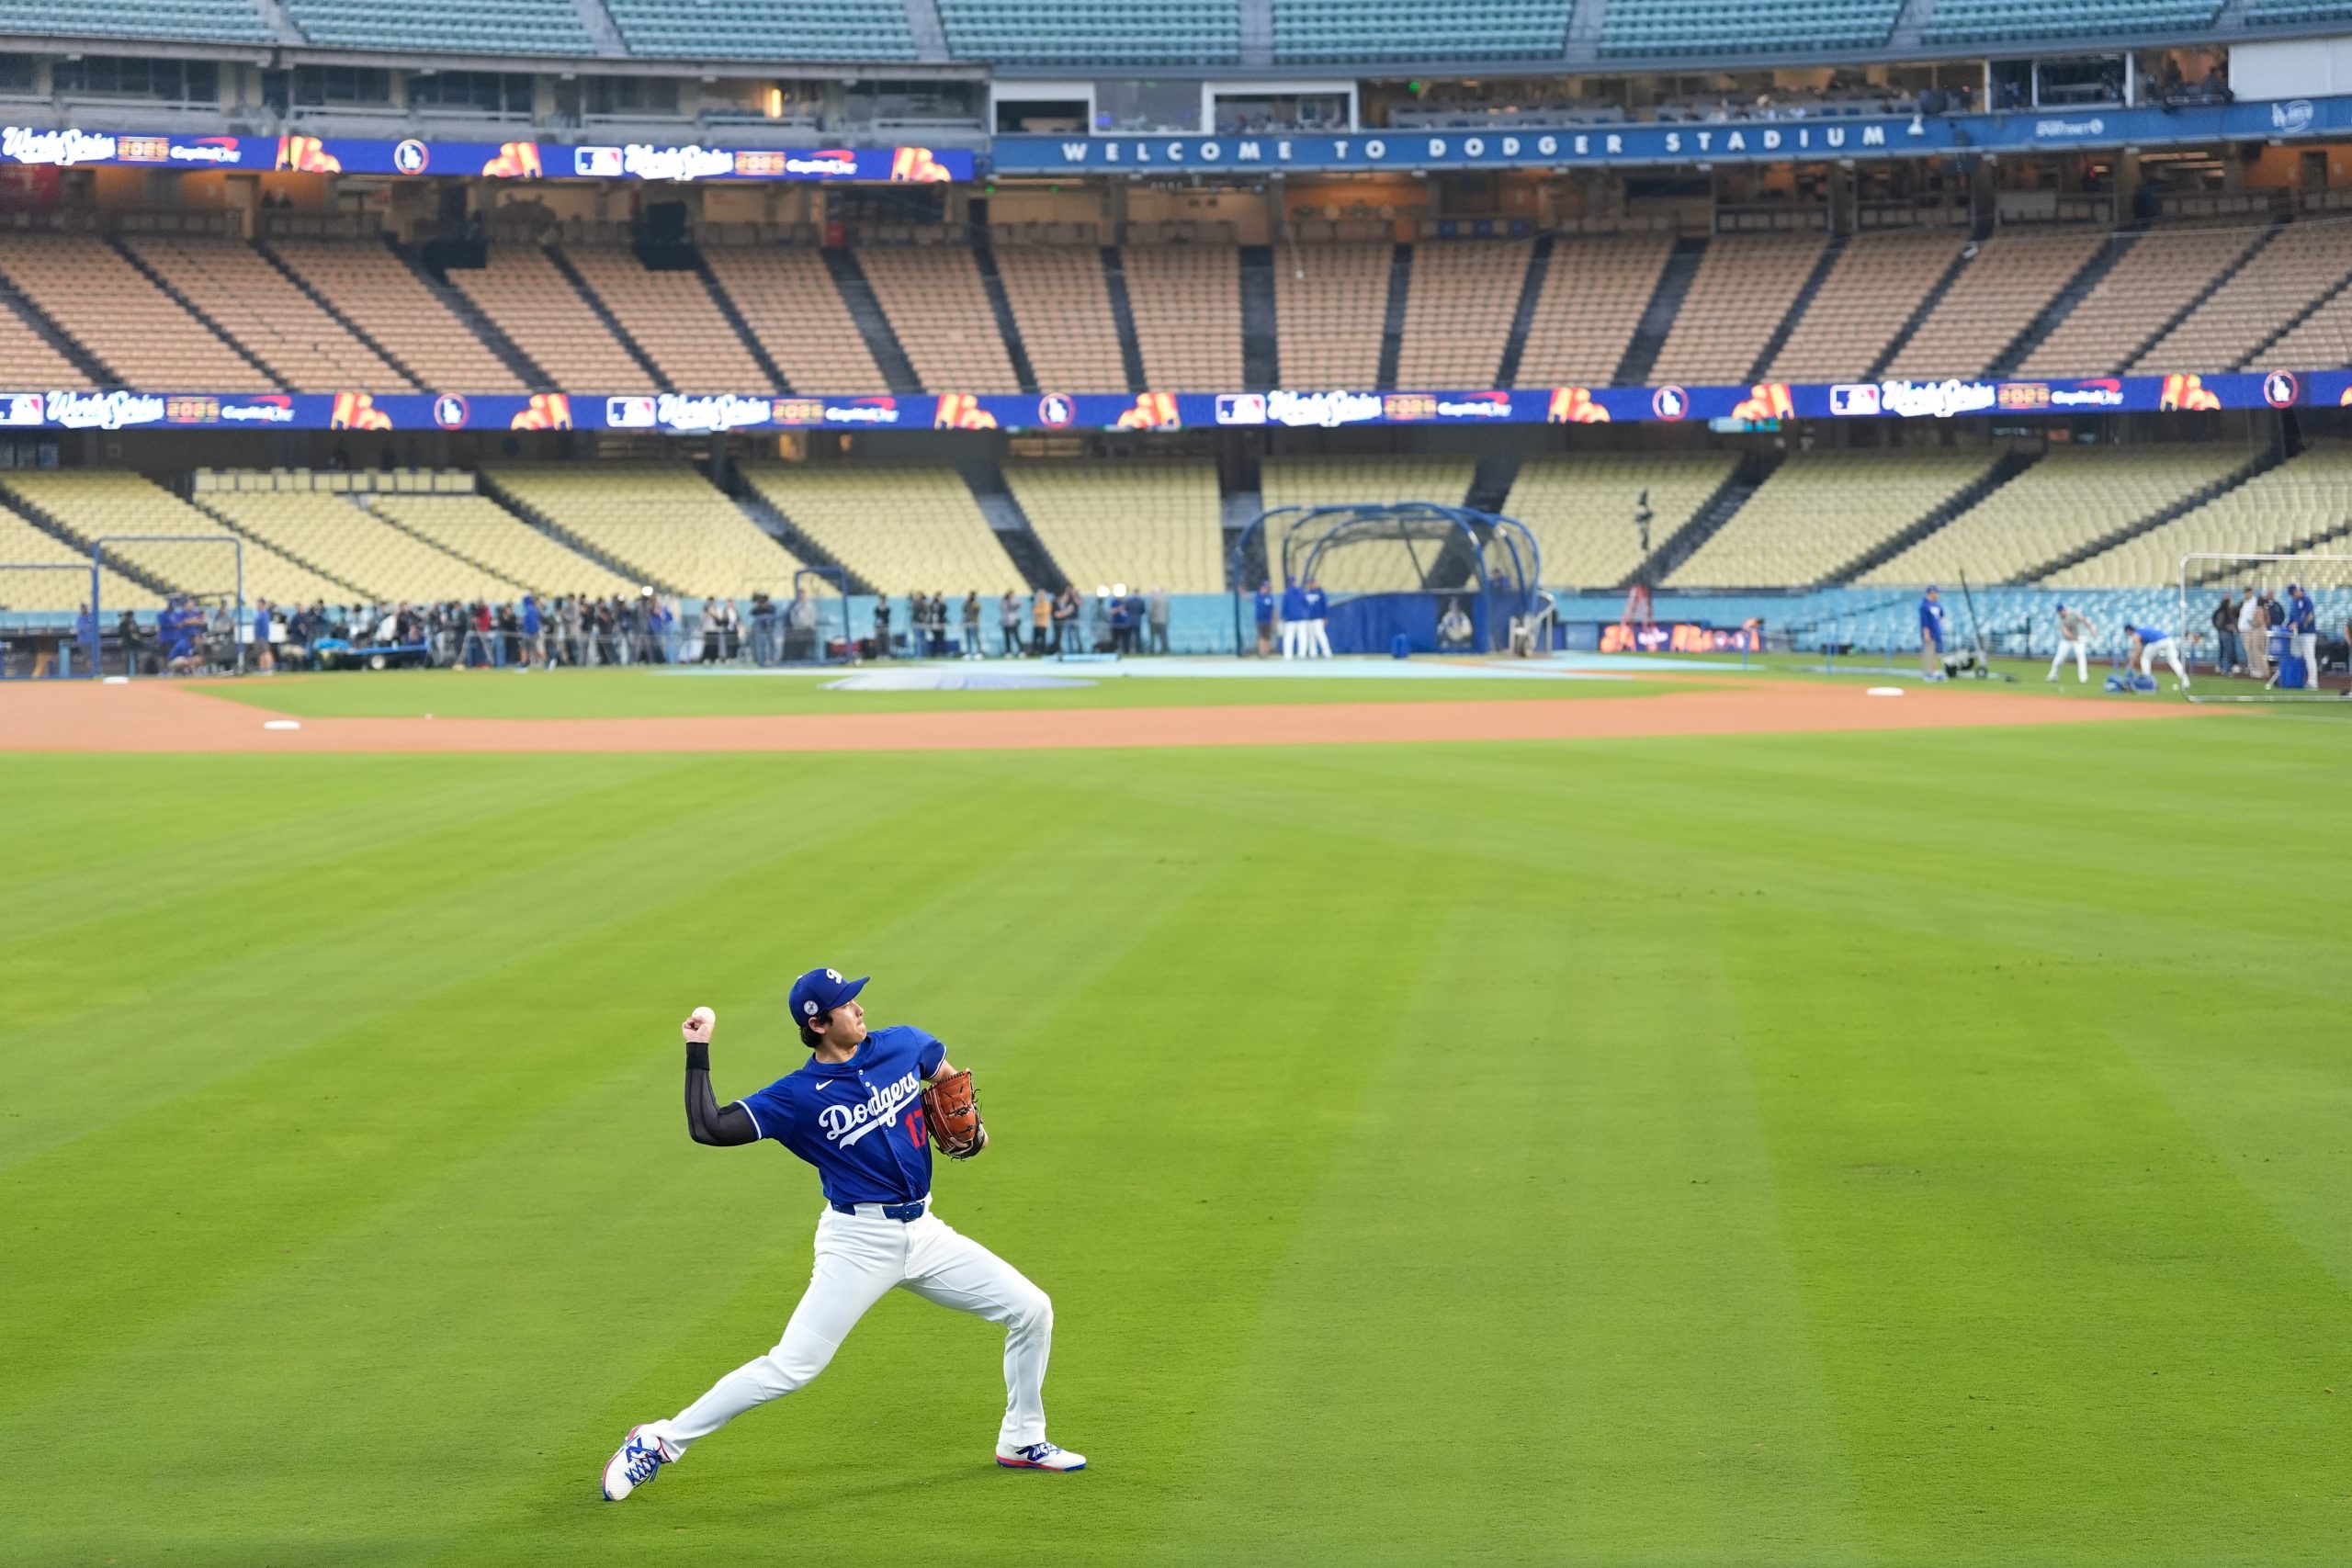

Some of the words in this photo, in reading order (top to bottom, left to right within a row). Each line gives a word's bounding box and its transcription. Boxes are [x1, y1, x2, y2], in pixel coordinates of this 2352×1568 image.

[1062, 141, 1292, 162] WELCOME
[1334, 139, 1386, 160] TO
[1429, 136, 1623, 158] DODGER
[1665, 125, 1886, 154] STADIUM
[819, 1071, 919, 1142] Dodgers
[905, 1108, 927, 1148] 17
